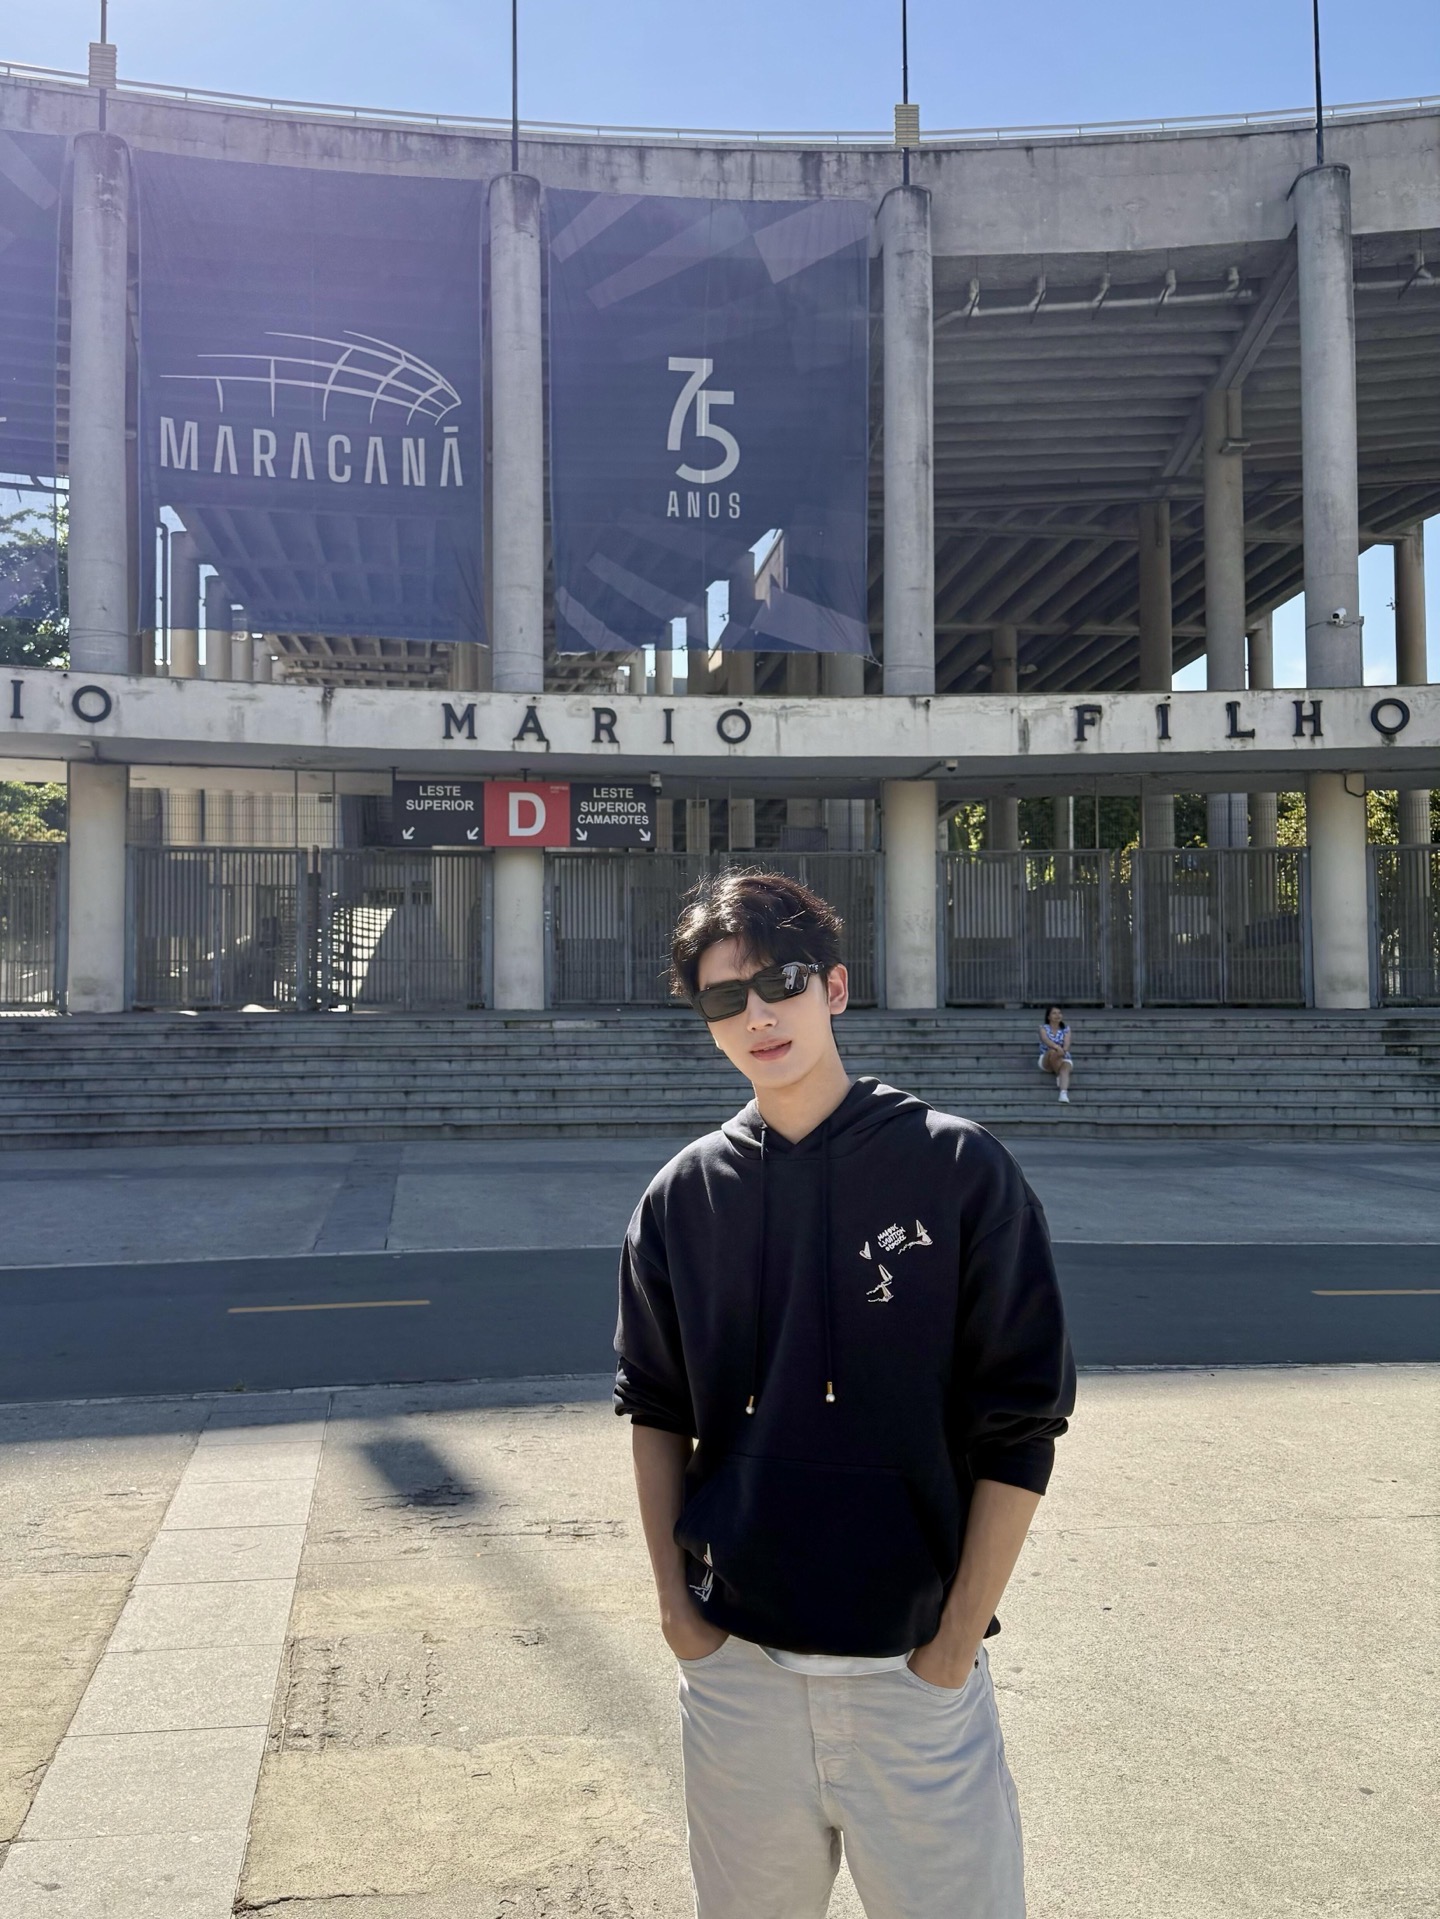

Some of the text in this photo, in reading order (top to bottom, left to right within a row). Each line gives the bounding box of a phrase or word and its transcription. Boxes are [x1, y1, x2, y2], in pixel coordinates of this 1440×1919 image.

[667, 357, 740, 484] 75
[667, 490, 740, 519] ANOS
[442, 698, 1410, 744] MARIO FILHO
[419, 785, 461, 796] LESTE
[593, 788, 634, 798] LESTE
[406, 800, 474, 811] SUPERIOR
[580, 802, 646, 813] SUPERIOR
[508, 792, 546, 836] D
[577, 814, 649, 825] CAMAROTES
